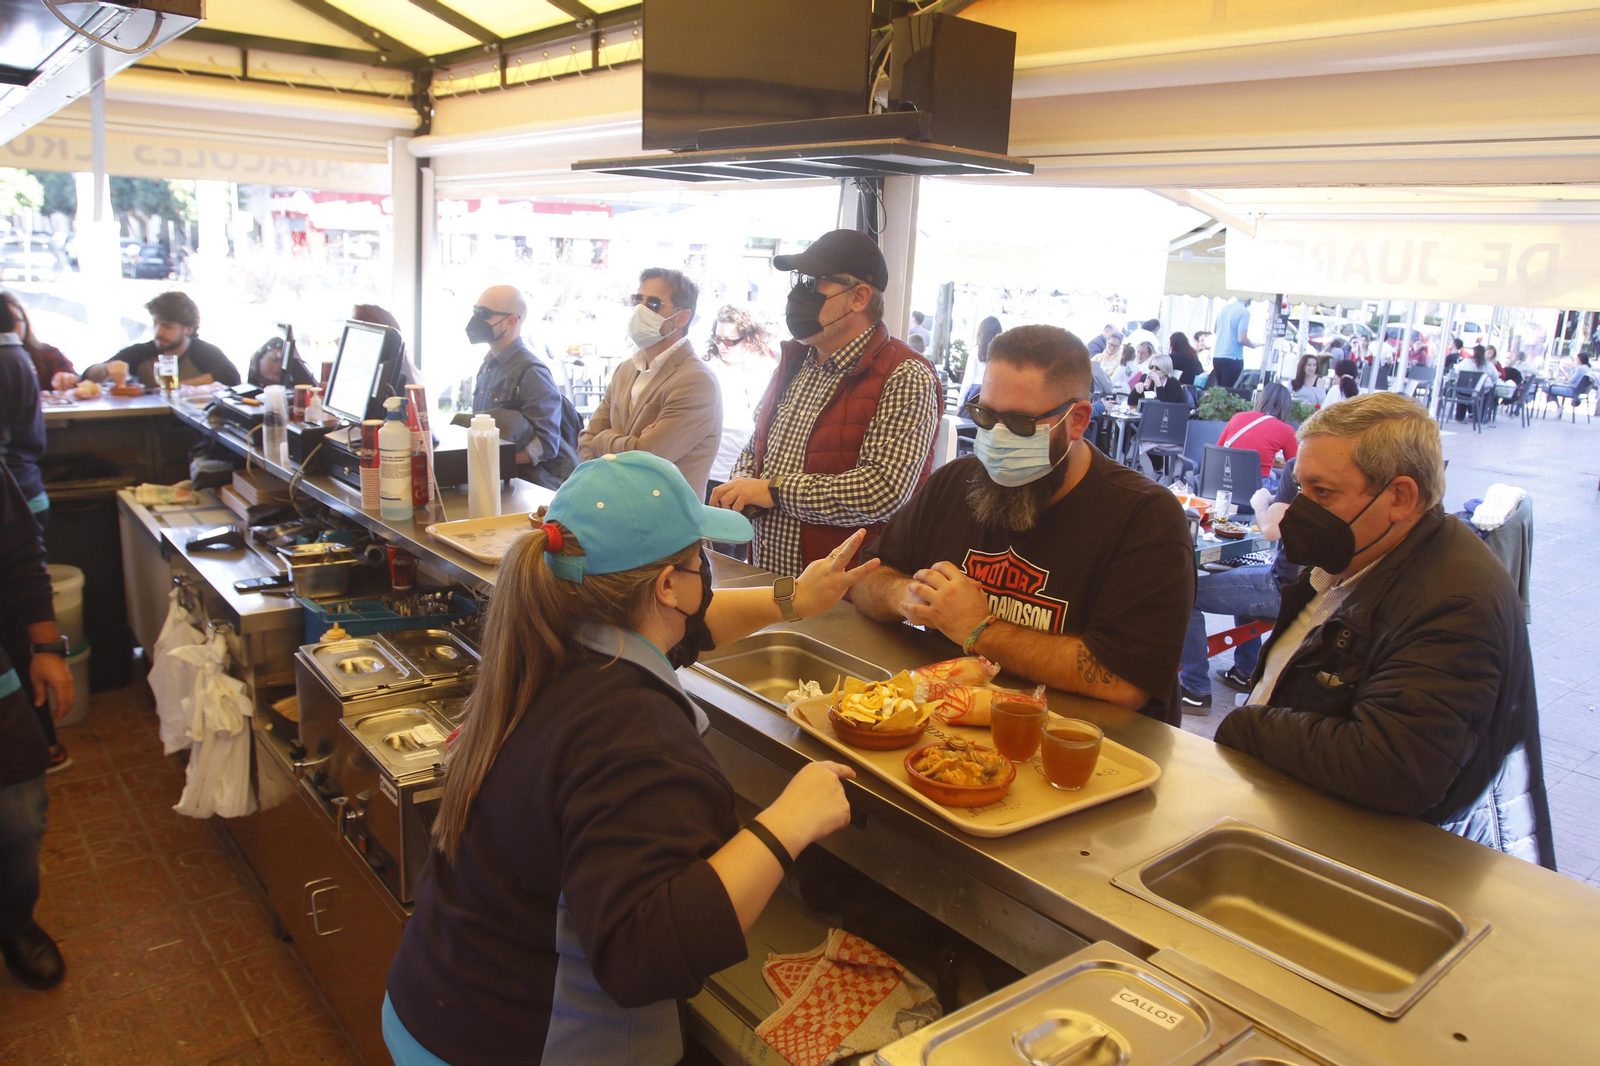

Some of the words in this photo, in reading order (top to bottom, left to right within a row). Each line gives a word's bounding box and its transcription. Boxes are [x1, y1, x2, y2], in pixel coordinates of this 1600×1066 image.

[975, 560, 1030, 593] MOTOR
[988, 595, 1053, 631] DAVIDSON
[1119, 993, 1178, 1025] CALLOS
